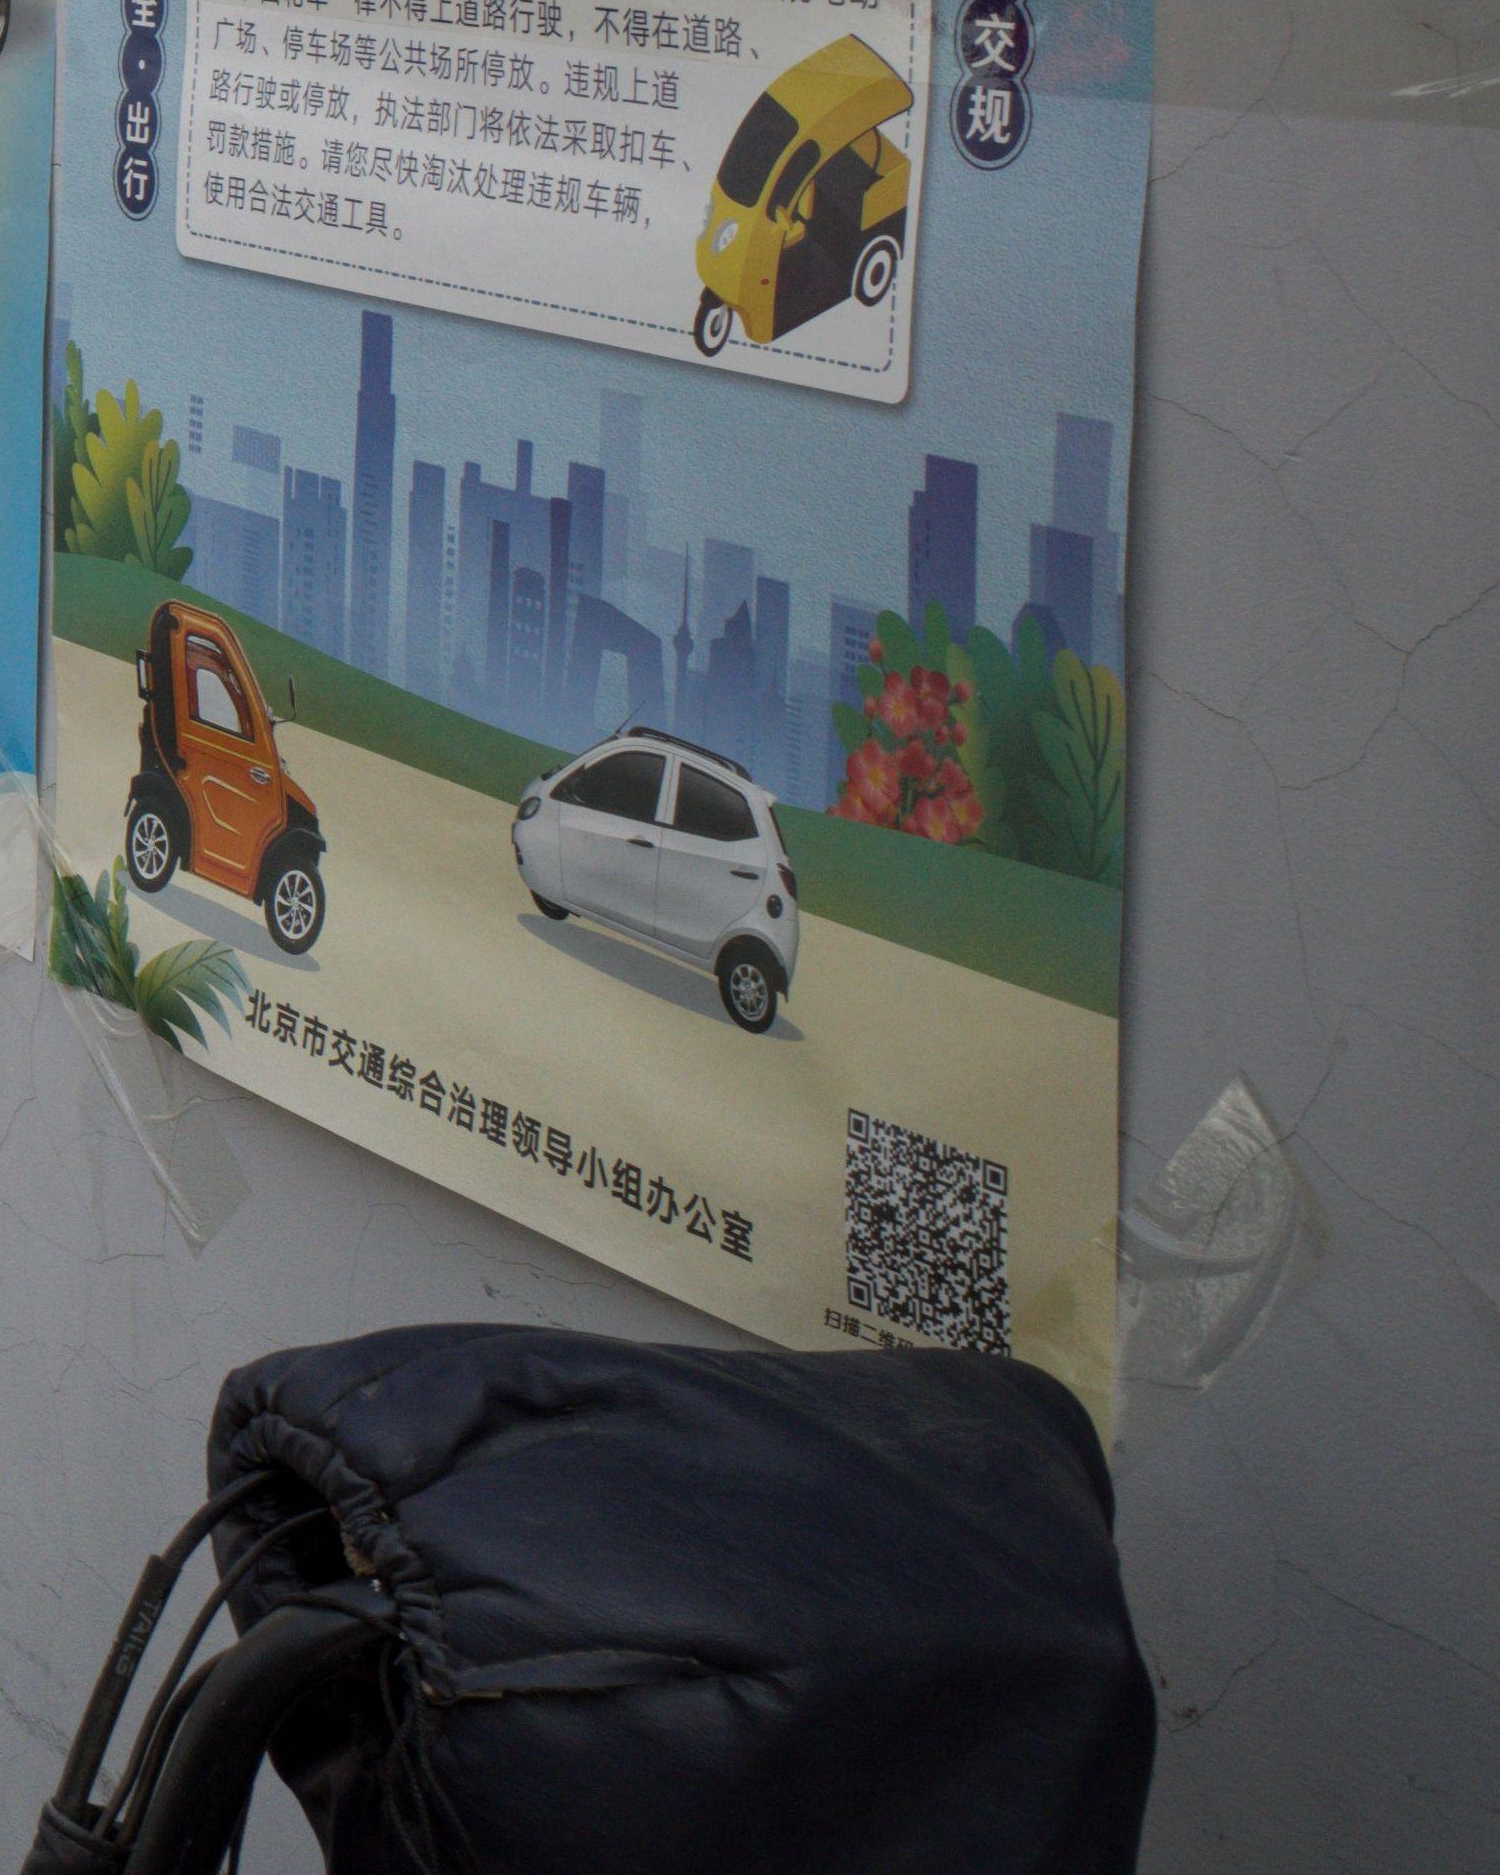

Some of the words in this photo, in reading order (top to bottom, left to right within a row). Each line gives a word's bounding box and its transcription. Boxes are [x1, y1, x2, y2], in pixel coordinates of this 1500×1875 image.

[212, 17, 680, 110] 广场、停车场等公共场所停放。违规上道
[208, 69, 691, 172] 路行驶或停放，执法部门将依法采取扣车、
[203, 171, 403, 241] 使用合法交通工具。
[206, 120, 651, 229] 罚款措施。请您尽快淘汰处理违规车辆，
[245, 987, 754, 1263] 北京市交通综合治理领导小组办公室
